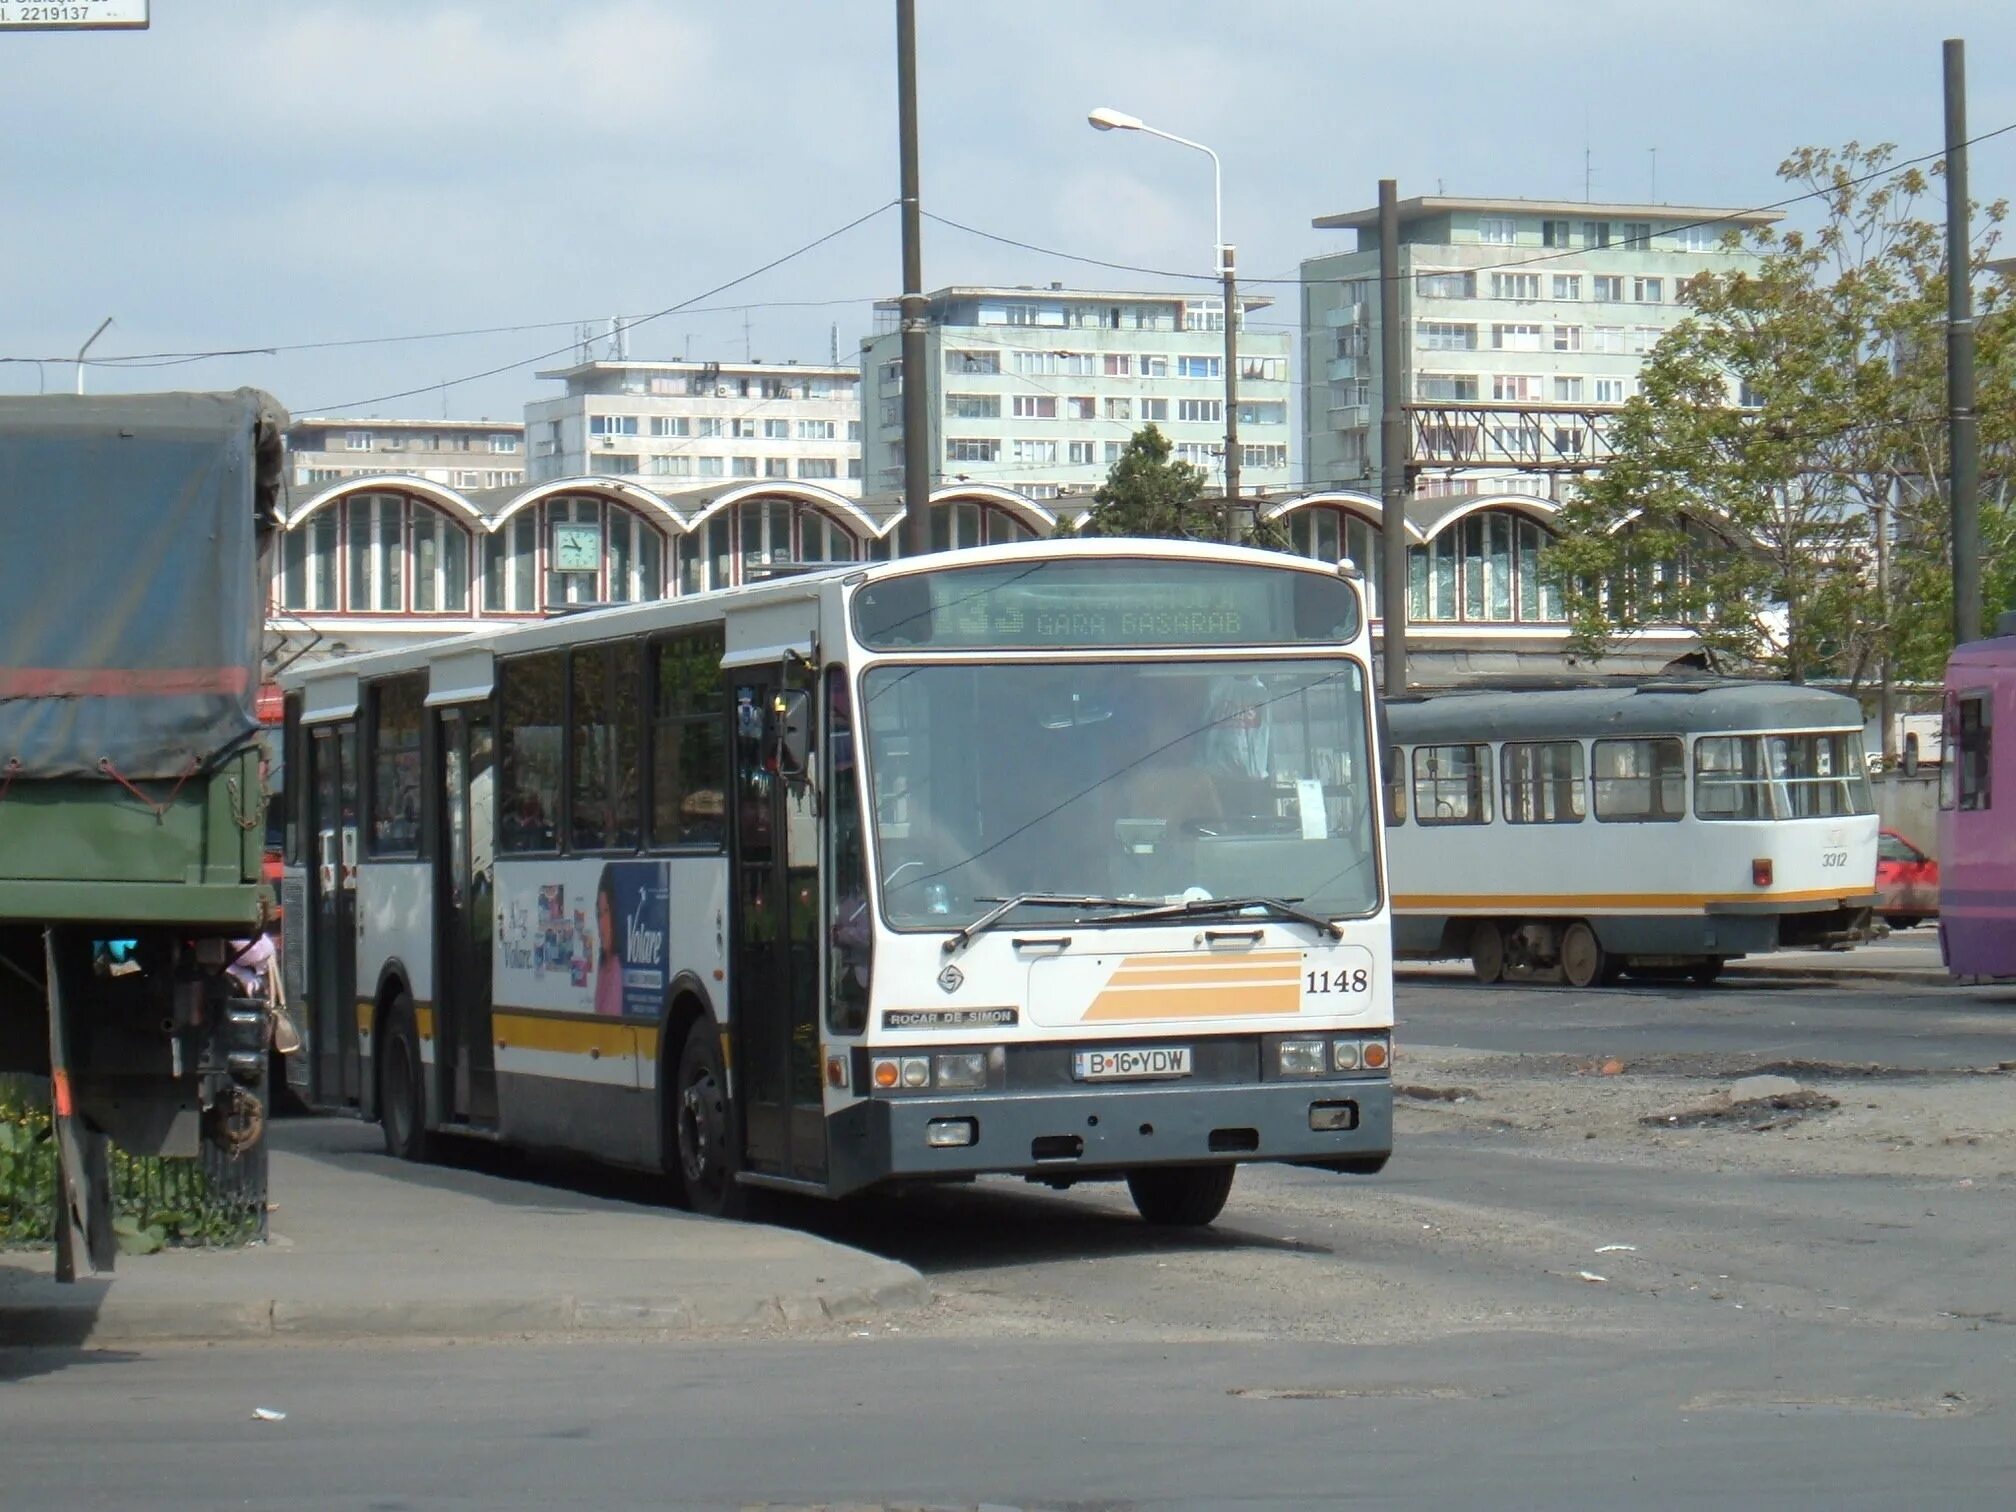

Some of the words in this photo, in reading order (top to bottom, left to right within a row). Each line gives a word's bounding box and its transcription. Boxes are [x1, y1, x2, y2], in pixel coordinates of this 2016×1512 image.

[20, 6, 89, 21] 2219137
[1821, 851, 1849, 868] 3312
[1306, 968, 1368, 994] 1148
[889, 1013, 938, 1026] ROCAR
[943, 1011, 965, 1024] DE
[968, 1009, 1012, 1023] SIMON
